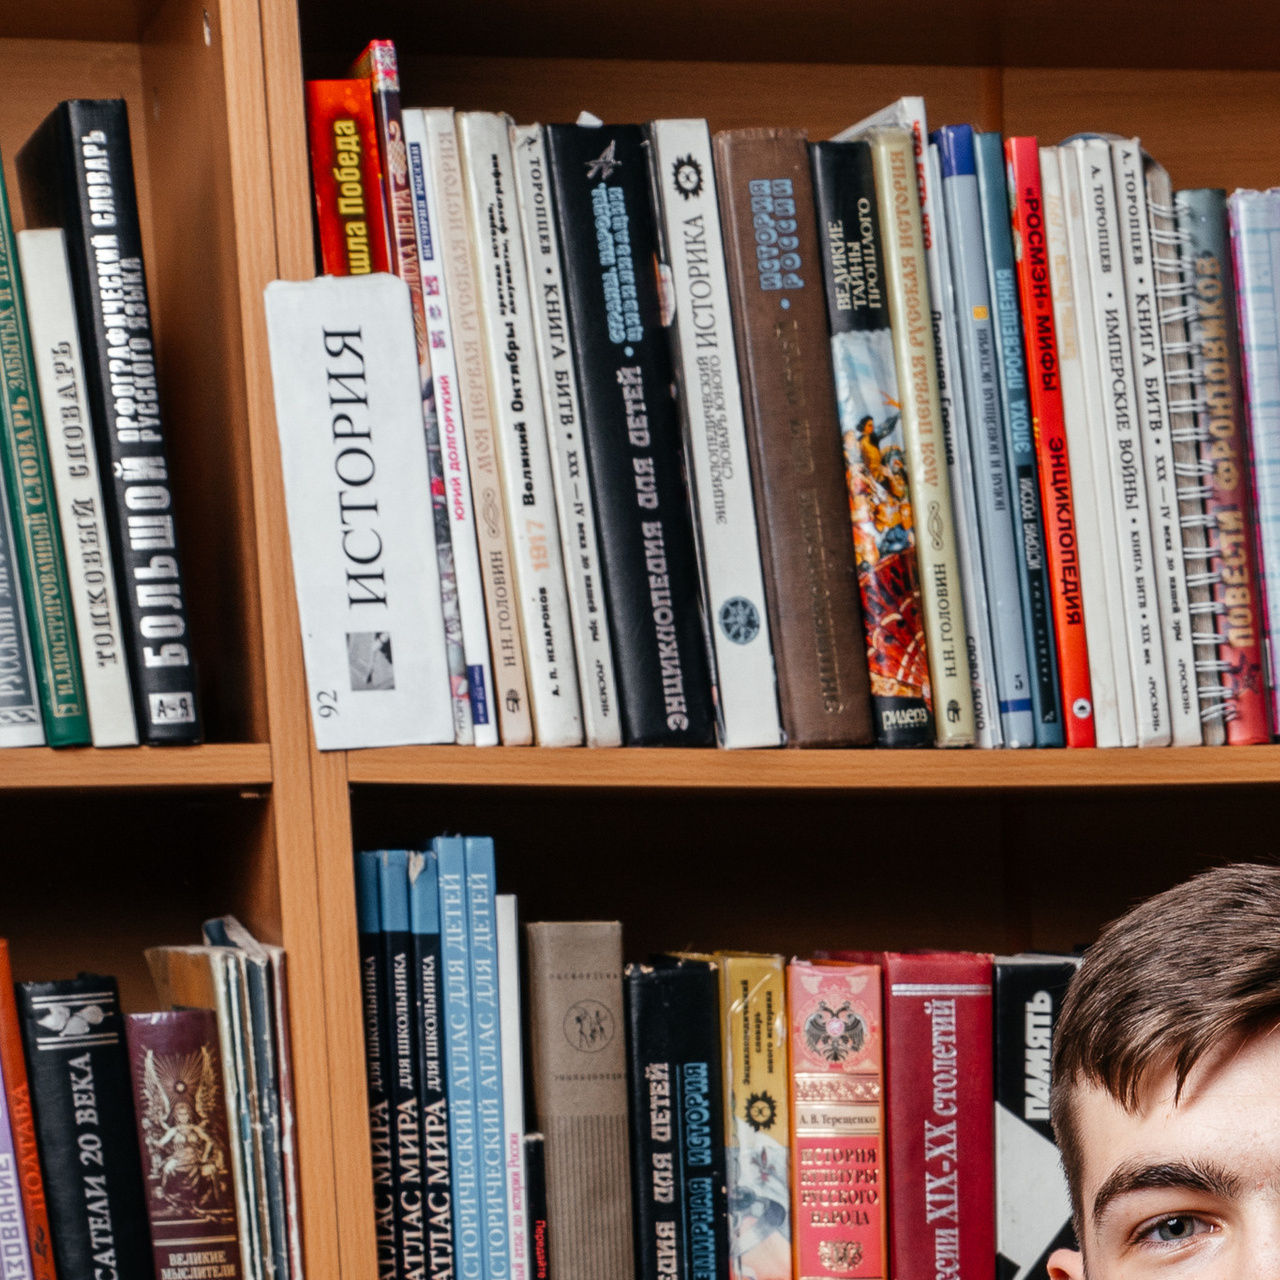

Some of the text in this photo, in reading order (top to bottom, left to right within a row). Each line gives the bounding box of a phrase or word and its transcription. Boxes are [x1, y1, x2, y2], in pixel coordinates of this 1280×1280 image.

[331, 120, 366, 213] Победа
[82, 130, 140, 442] ОРФОГРАФИЧЕСКИЙ СЛОВАРЬ
[684, 215, 718, 349] ИСТОРИКА
[750, 180, 781, 290] ИСТОРИЯ
[771, 180, 800, 287] РОССИИ
[828, 221, 853, 311] ВЕЛИКИЕ
[849, 242, 866, 310] ТАЙНЫ
[857, 198, 882, 308] ПРОШЛОГО
[888, 150, 939, 486] МОЯ ПЕРВАЯ РУССКАЯ ИСТОРИЯ
[995, 269, 1029, 452] ЭПОХА ПРОСВЕЩЕНИЯ
[1136, 293, 1163, 430] КНИГА БИТВ
[129, 338, 162, 441] РУССКОГО
[1104, 308, 1140, 511] ИМПЕРСКИЕ ВОЙНЫ
[11, 396, 44, 506] СЛОВАРЬ
[51, 340, 116, 667] ТОЛКОВЫЙ СЛОВАРЬ
[323, 325, 388, 609] ИСТОРИЯ
[1034, 315, 1082, 626] МИФЫ ЭНЦИКЛОПЕДИЯ
[114, 457, 188, 666] БОЛЬШОЙ
[619, 366, 689, 731] ЭНЦИКЛОПЕДИЯ ДЛЯ ДЕТЕЙ
[317, 689, 339, 719] 92
[468, 872, 492, 950] ДЕТЕЙ
[394, 953, 411, 1058] ШКОЛЬНИКА
[473, 956, 497, 1005] ДЛЯ
[68, 1053, 99, 1125] ВЕКА
[397, 1061, 413, 1089] ДЛЯ
[476, 1010, 500, 1092] АТЛАС
[646, 1063, 671, 1142] ДЕТЕЙ
[923, 999, 957, 1115] столетий
[1025, 990, 1052, 1121] ПАМЯТЬ
[79, 1135, 104, 1166] 20
[396, 1098, 421, 1184] МИРА
[684, 1063, 710, 1165] ИСТОРИЯ
[653, 1152, 675, 1203] ДЛЯ
